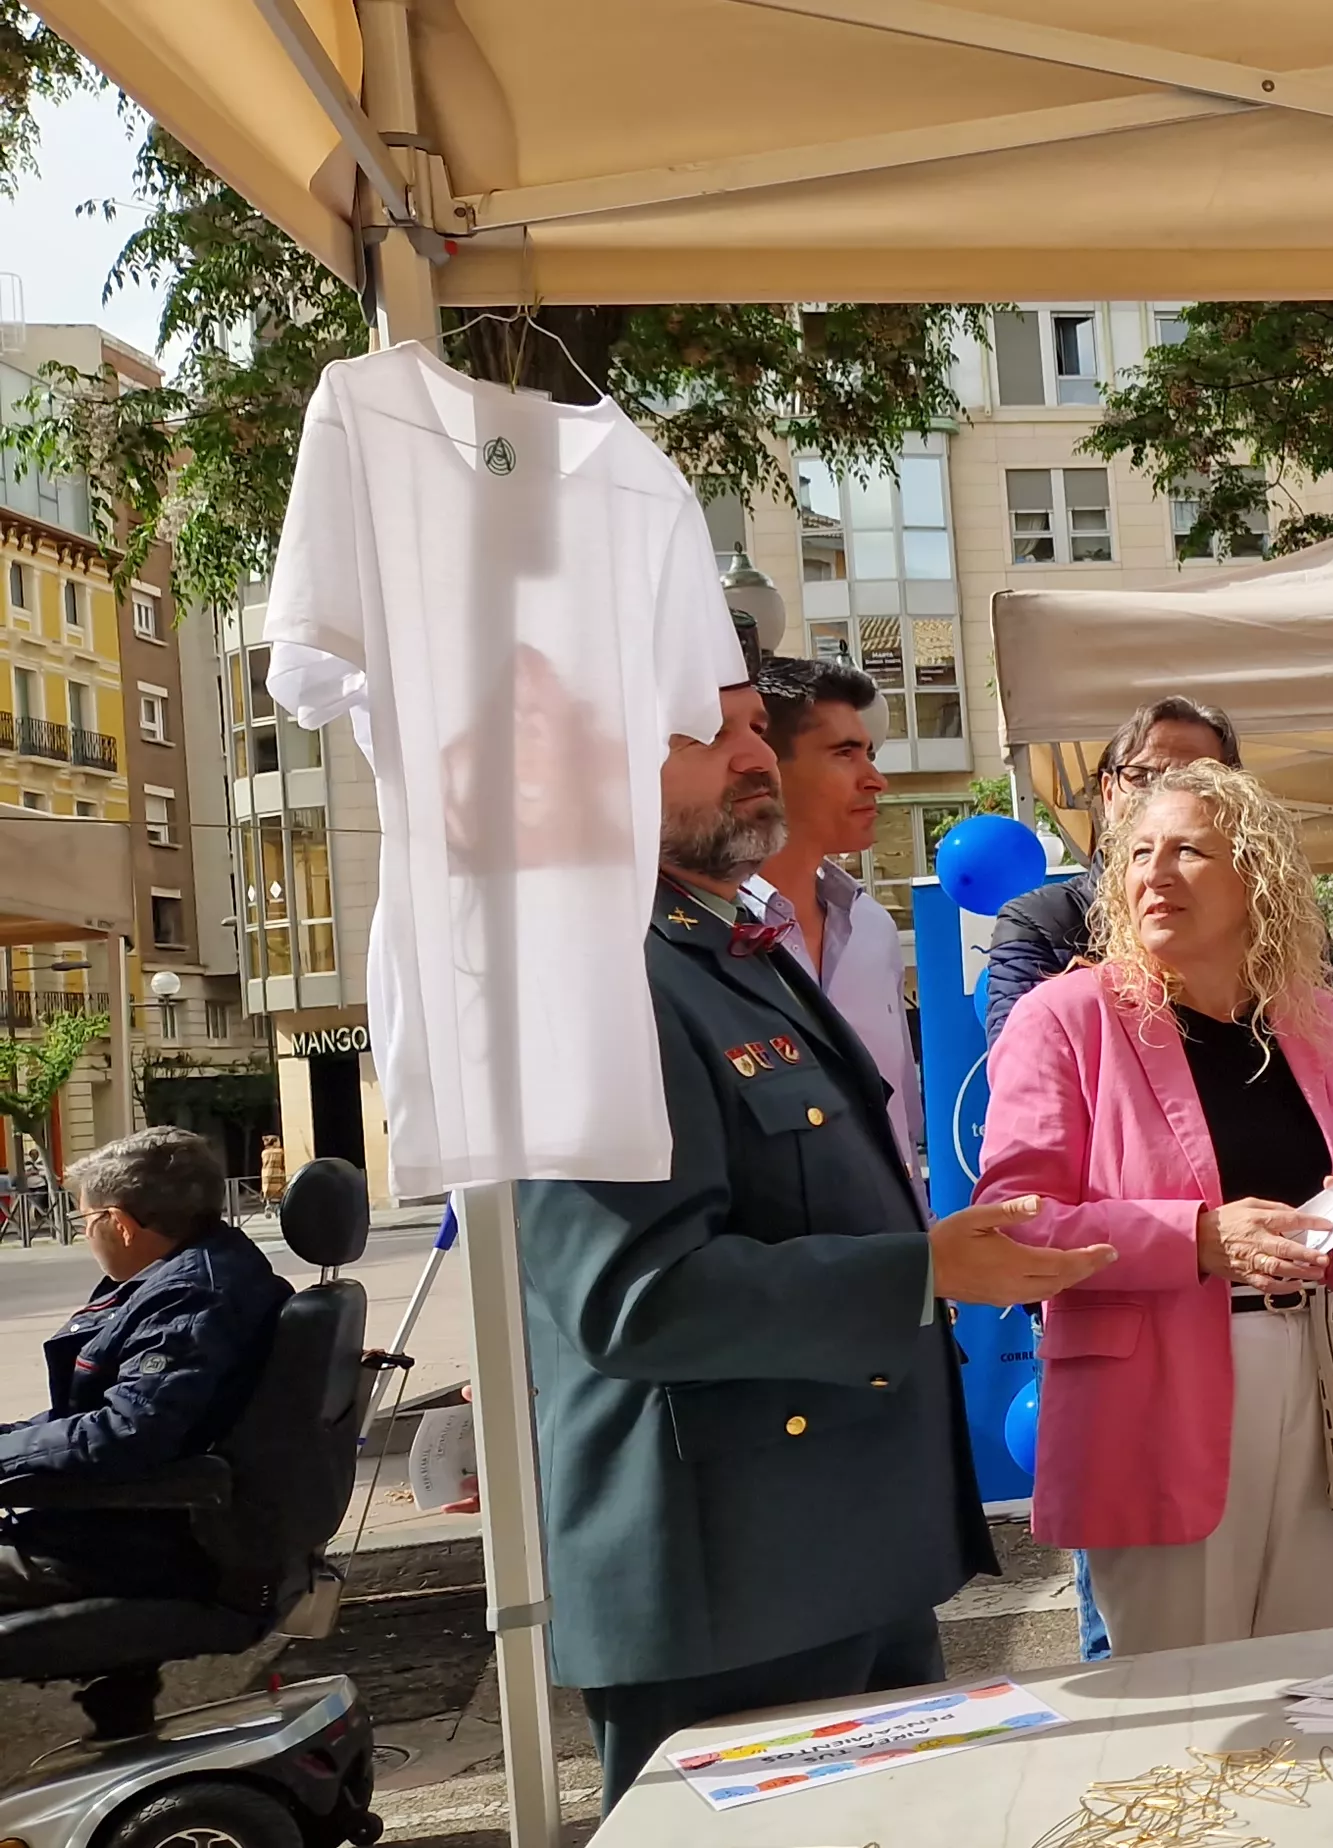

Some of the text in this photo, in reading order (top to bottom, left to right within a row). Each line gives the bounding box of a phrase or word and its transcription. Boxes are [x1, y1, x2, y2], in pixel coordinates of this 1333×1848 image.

[291, 1026, 368, 1056] MANGO
[761, 1714, 955, 1764] PENSAMIENTOS
[803, 1727, 931, 1765] AIREA TUS
